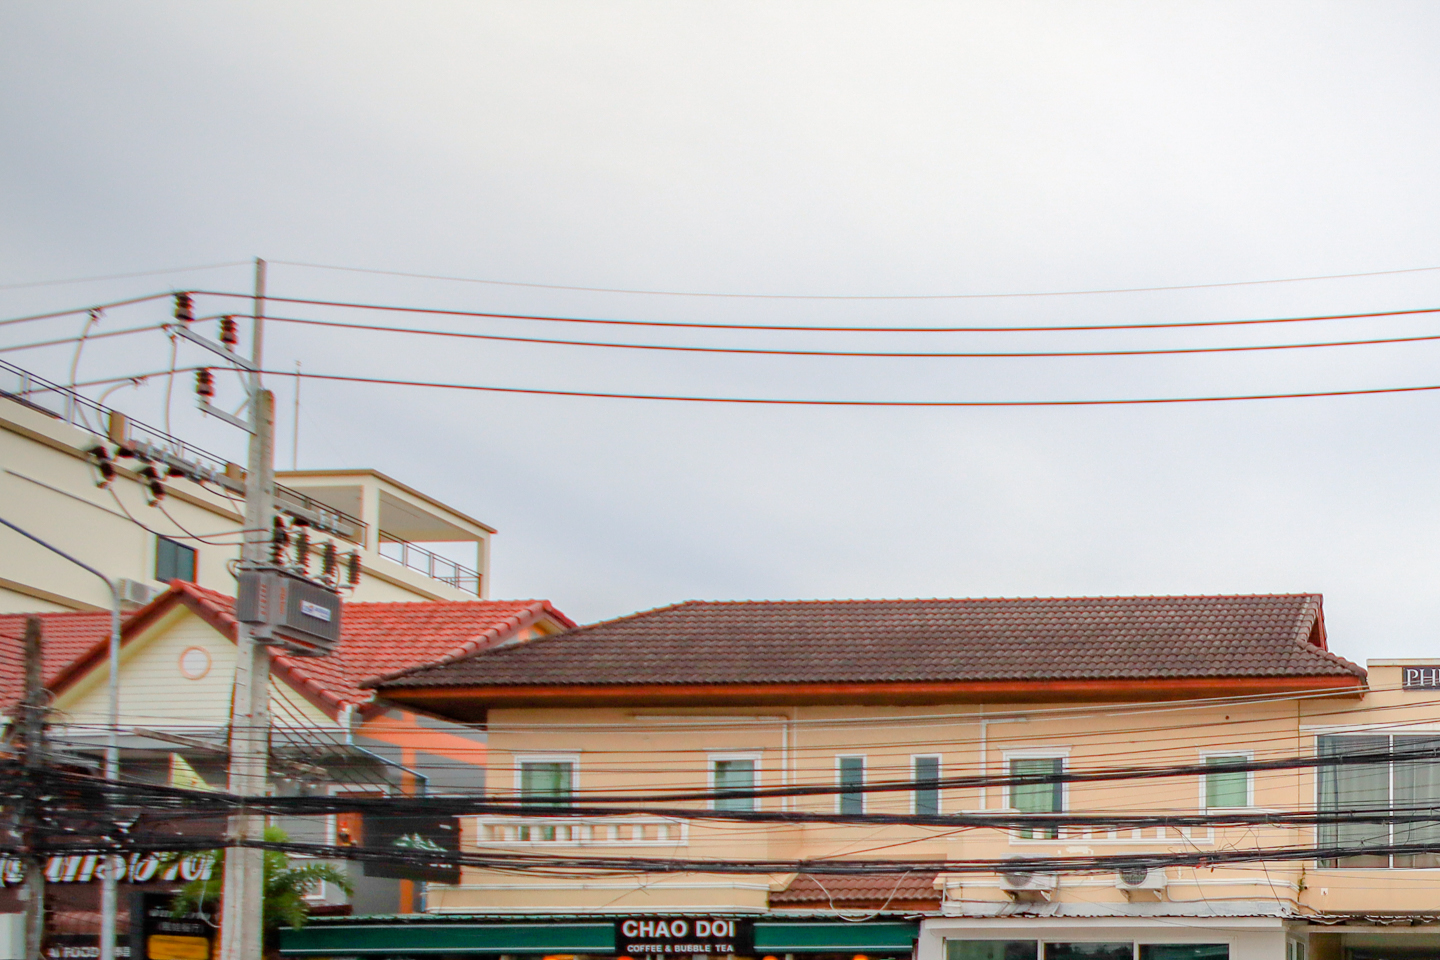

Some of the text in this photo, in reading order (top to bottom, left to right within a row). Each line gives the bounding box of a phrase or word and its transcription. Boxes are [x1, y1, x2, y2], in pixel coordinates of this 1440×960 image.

[622, 920, 736, 938] CHAO DOI
[626, 944, 734, 953] COFFEE & BUBBLE TEA
